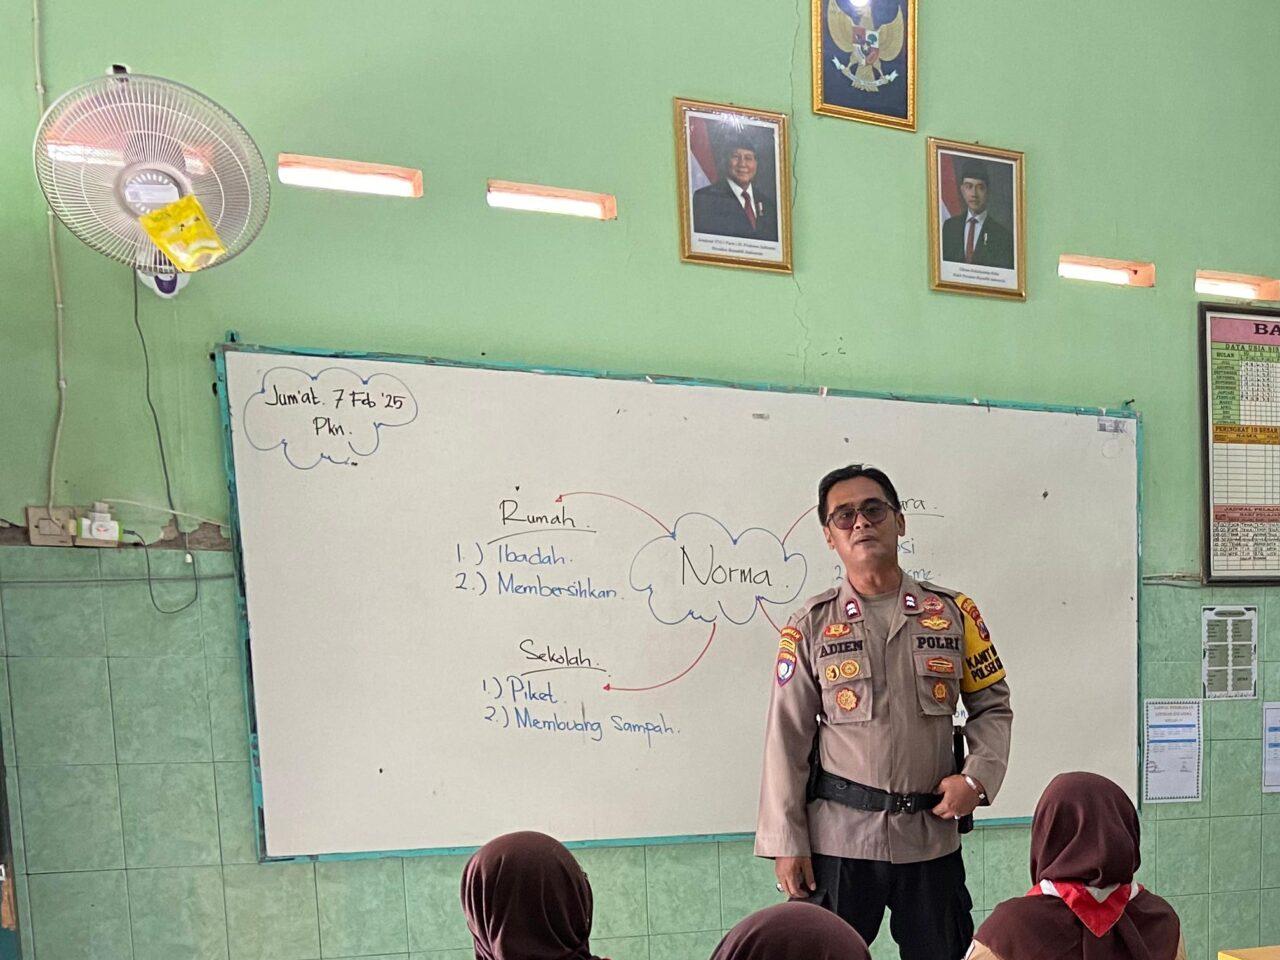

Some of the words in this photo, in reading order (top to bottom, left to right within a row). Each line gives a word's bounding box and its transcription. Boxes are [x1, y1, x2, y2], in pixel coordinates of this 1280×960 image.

[1225, 343, 1245, 351] DATA
[332, 388, 345, 409] 7
[349, 390, 376, 409] Feb
[819, 639, 863, 659] ADIEN
[916, 636, 961, 651] POLRI
